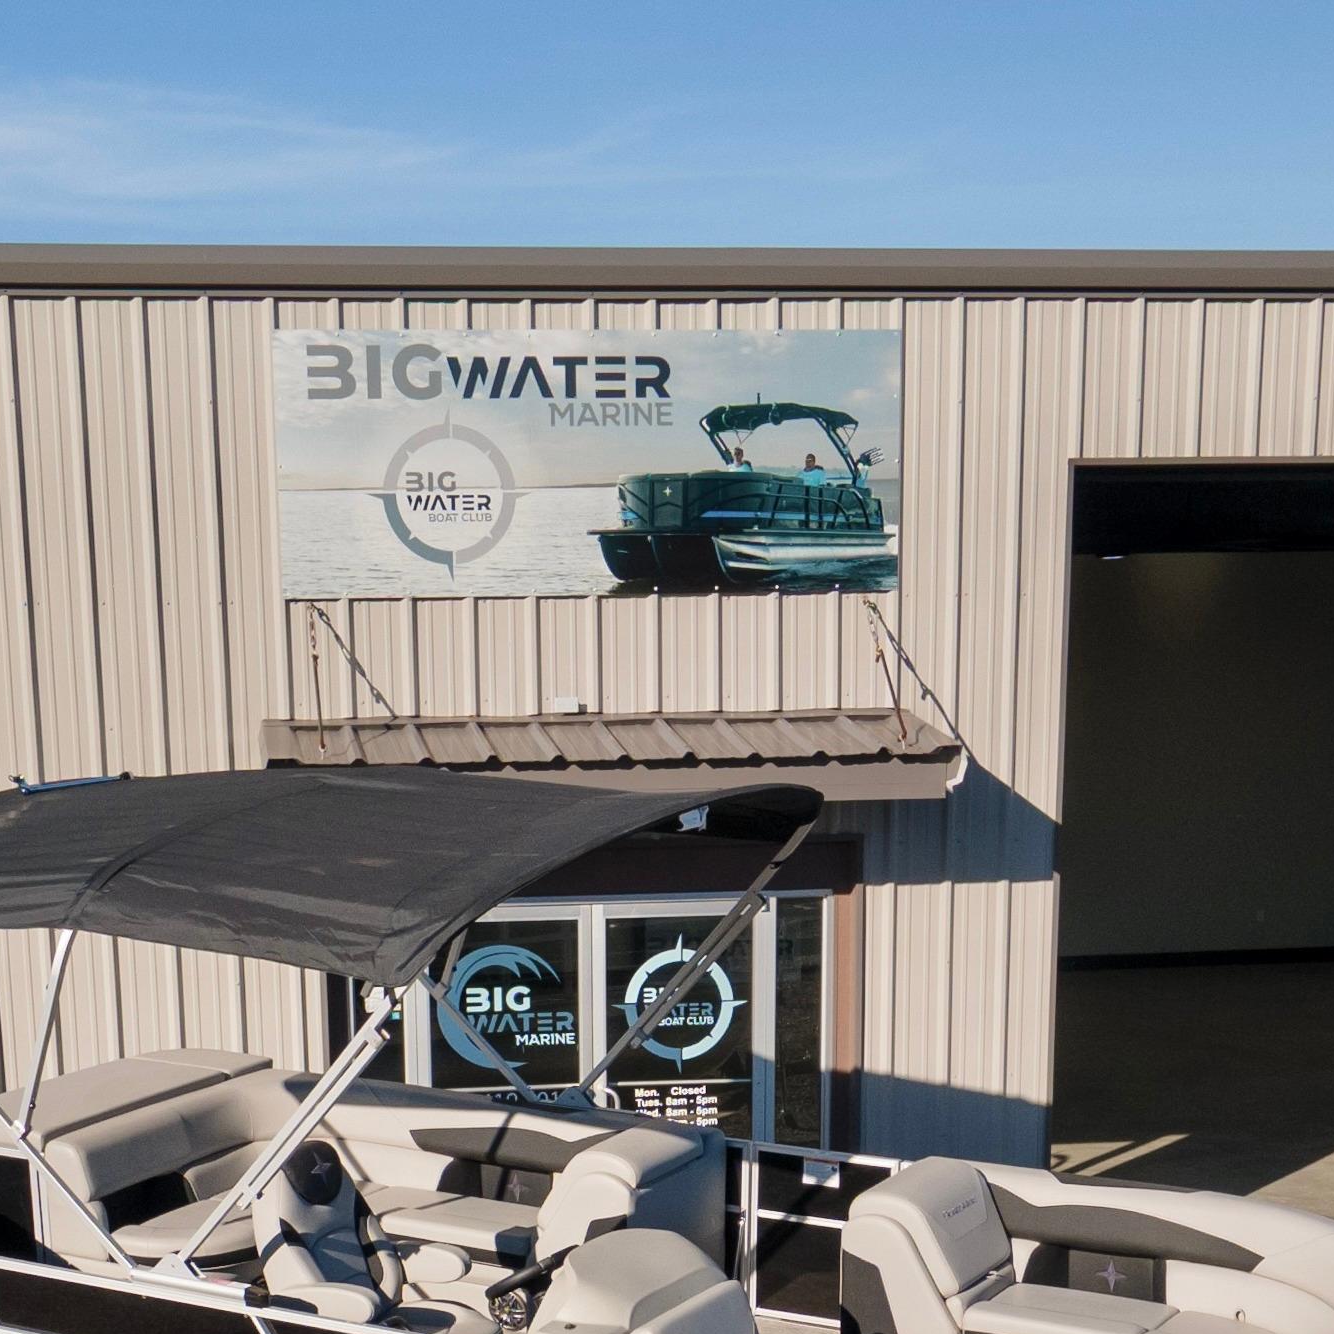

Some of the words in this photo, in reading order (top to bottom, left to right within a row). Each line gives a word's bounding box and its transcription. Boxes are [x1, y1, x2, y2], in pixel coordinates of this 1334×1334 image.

[547, 402, 674, 427] MARINE
[405, 471, 457, 492] BIG
[407, 494, 492, 511] WATER
[428, 513, 458, 523] BOAT
[461, 512, 493, 522] CLUB
[465, 985, 532, 1013] BIG
[467, 1011, 574, 1034] WATER
[687, 1016, 714, 1025] CLUB
[514, 1032, 576, 1046] MARINE
[634, 1087, 660, 1097] Mon.
[670, 1085, 707, 1096] Closed
[635, 1098, 663, 1108] Tues.
